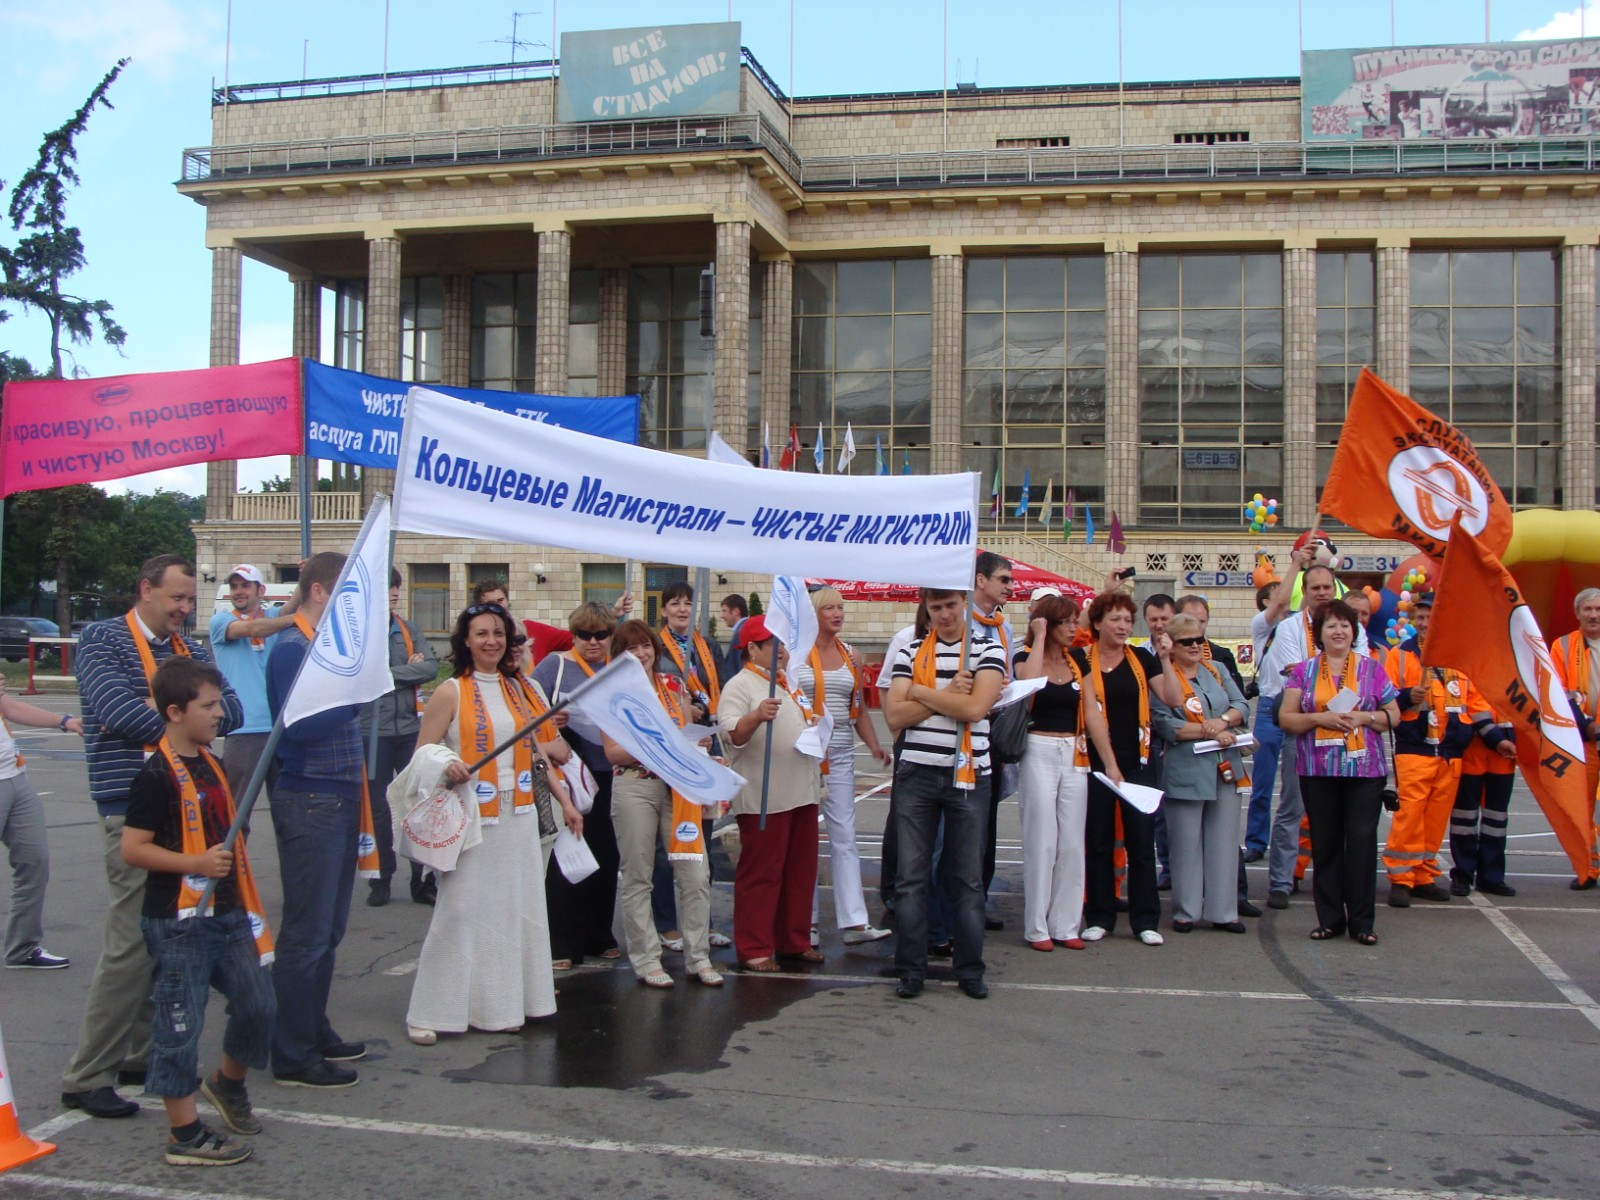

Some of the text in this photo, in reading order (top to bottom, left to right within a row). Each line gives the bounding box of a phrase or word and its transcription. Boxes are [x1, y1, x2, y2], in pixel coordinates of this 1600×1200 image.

[612, 30, 667, 66] ВСЕ
[592, 51, 727, 117] СТАДИОН!
[630, 58, 667, 86] НА
[13, 414, 122, 445] красивую,
[130, 394, 287, 428] процветающую
[22, 428, 225, 477] и чистую Москву!
[309, 421, 398, 455] аслуга ГУП
[415, 435, 569, 509] Кольцевые
[571, 475, 726, 534] Магистрали
[751, 506, 850, 543] ЧИСТЫЕ
[843, 510, 972, 546] МАГИСТРАЛИ
[1215, 572, 1228, 586] D
[1376, 557, 1387, 571] 3
